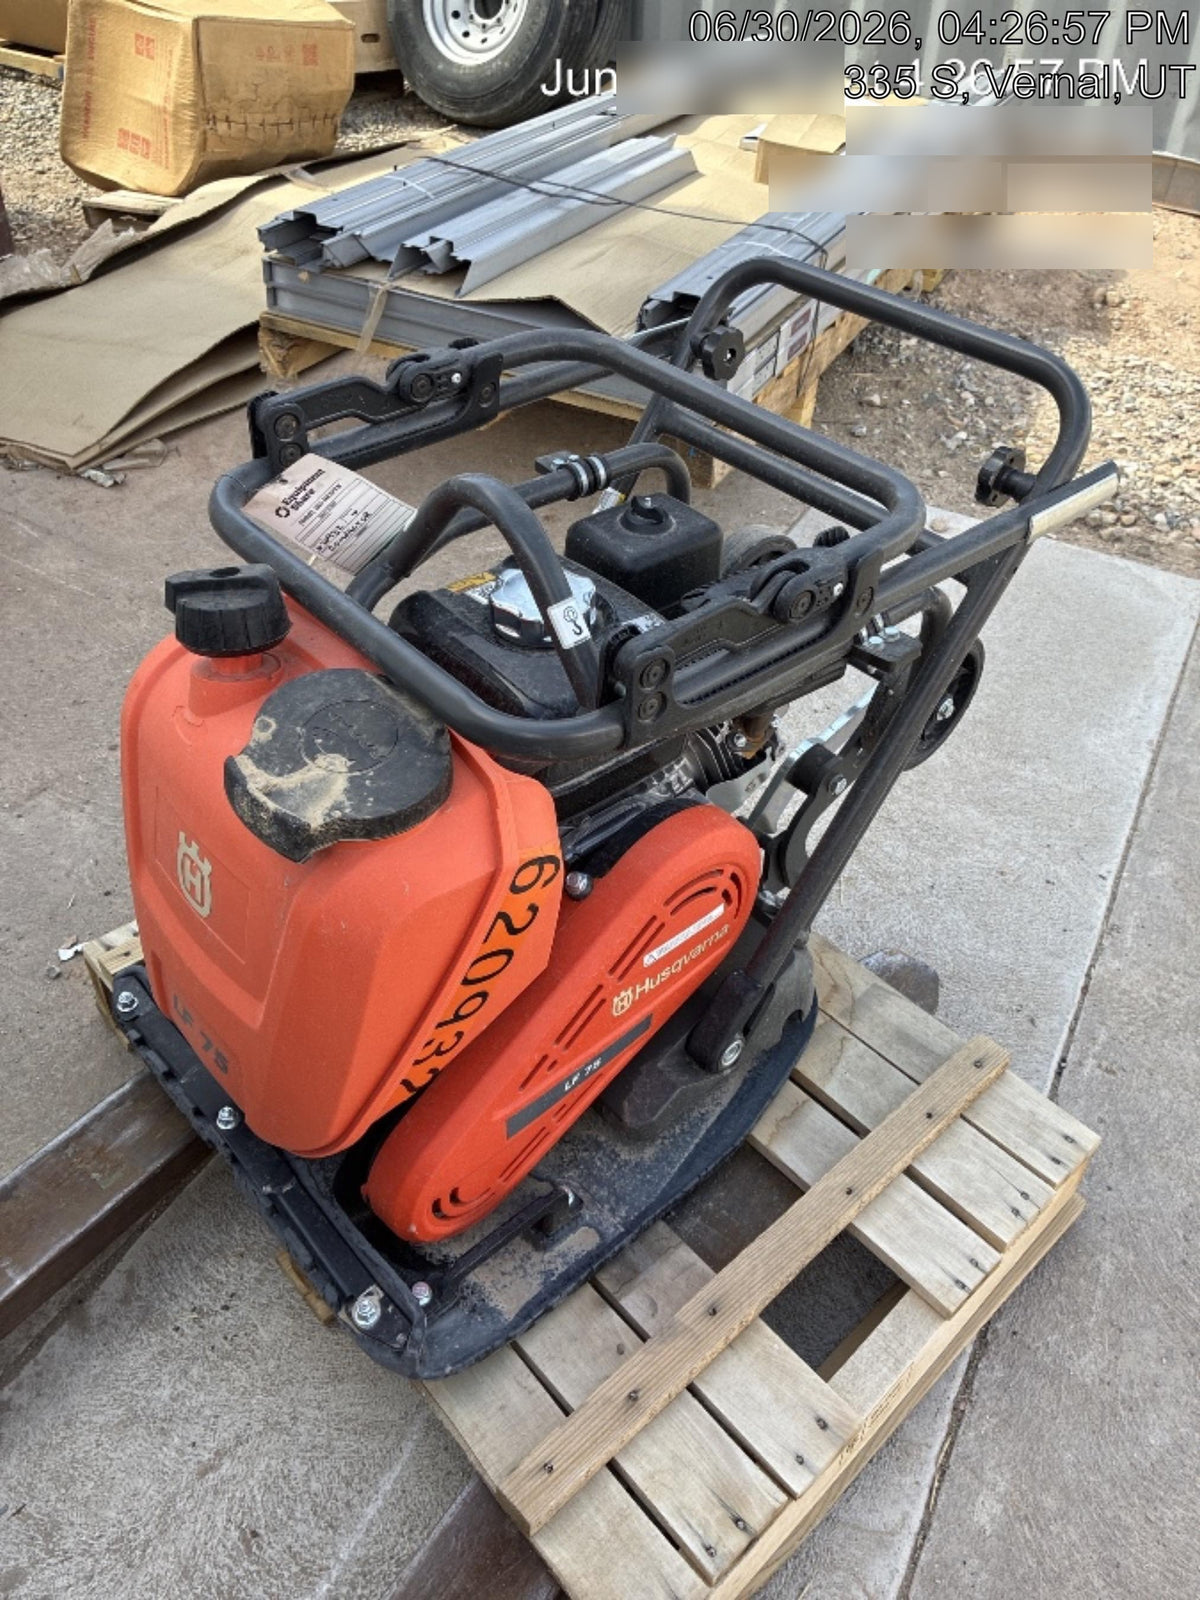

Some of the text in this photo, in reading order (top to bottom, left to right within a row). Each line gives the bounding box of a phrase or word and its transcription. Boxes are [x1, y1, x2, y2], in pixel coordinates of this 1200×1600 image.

[635, 924, 729, 1000] Husqvarna
[173, 994, 229, 1075] LF 75
[564, 1056, 602, 1091] LF 75
